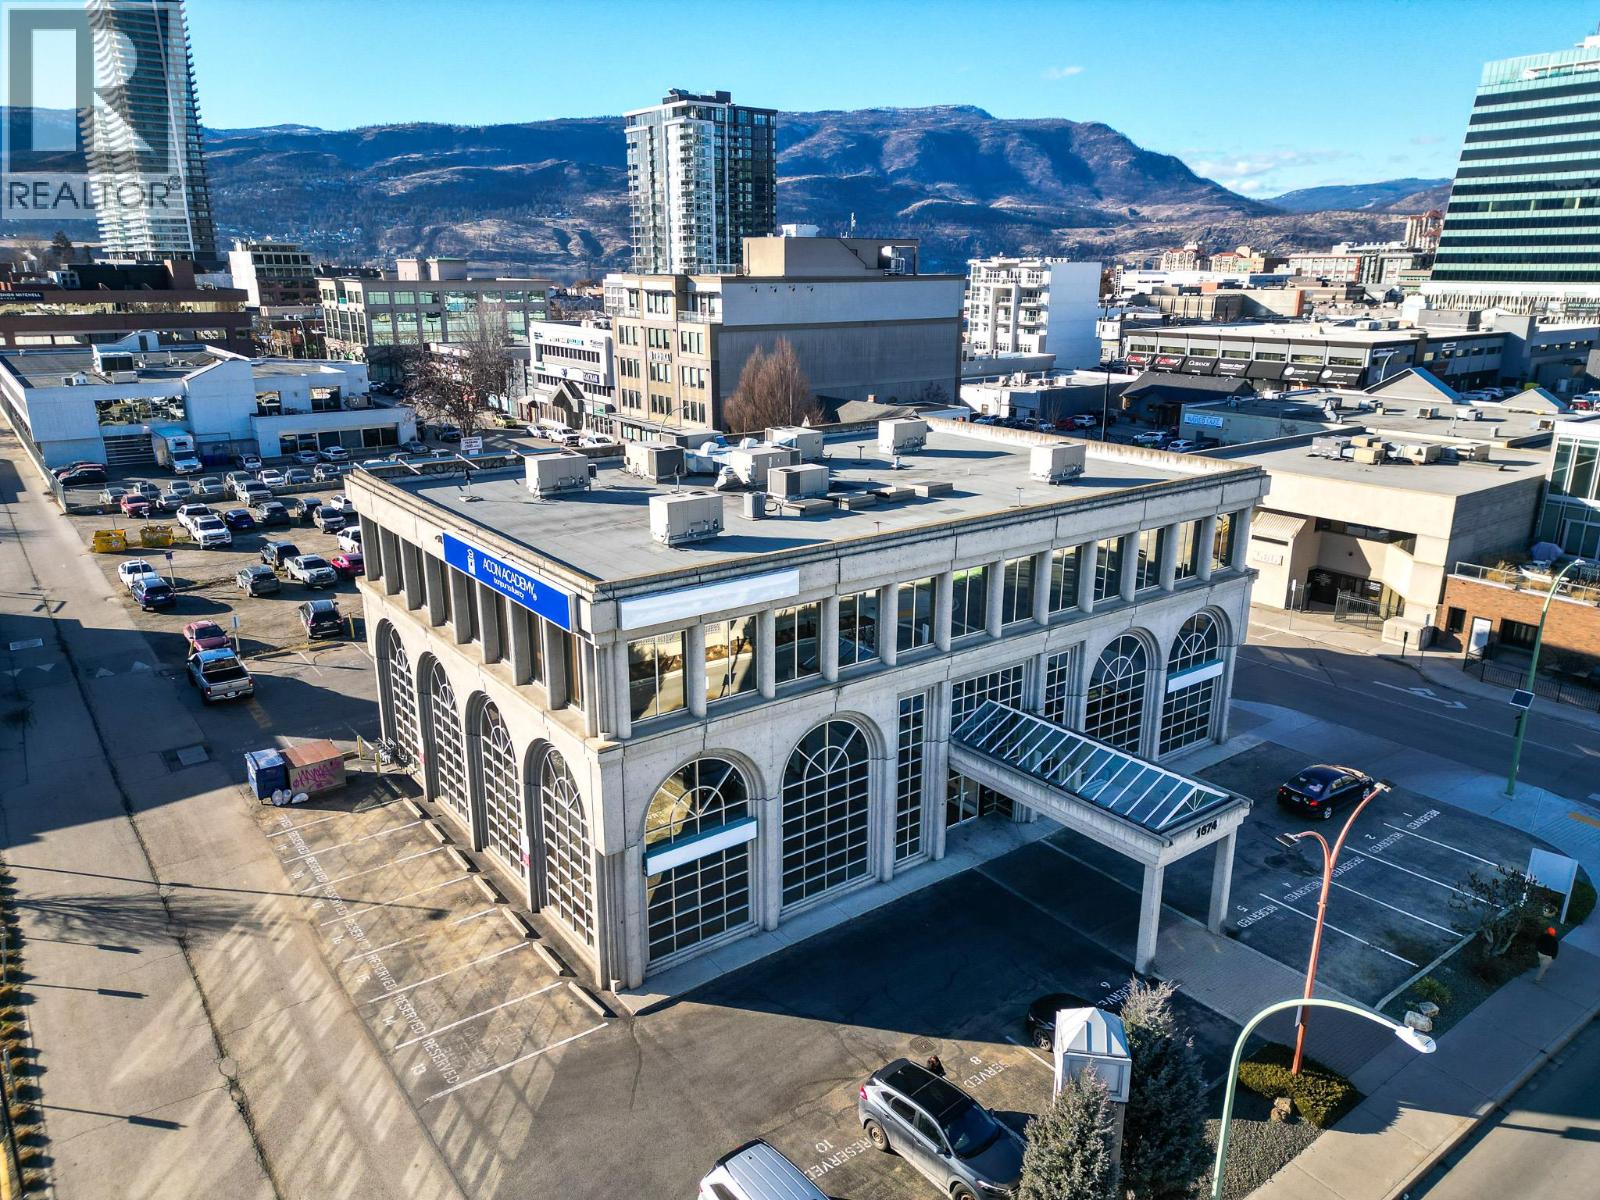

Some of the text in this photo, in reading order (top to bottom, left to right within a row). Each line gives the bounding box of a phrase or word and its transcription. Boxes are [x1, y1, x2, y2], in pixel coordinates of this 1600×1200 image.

[502, 568, 535, 596] ACADEMY
[1196, 819, 1218, 838] 1674
[1406, 809, 1440, 830] RESERVED
[1368, 832, 1404, 854] RESERVED
[1236, 905, 1249, 913] 5
[1236, 905, 1278, 928] RESERVED
[366, 953, 398, 991] RESERVED
[393, 993, 426, 1035] RESERVED
[420, 1037, 460, 1084] RESERVED
[969, 1055, 982, 1065] 8
[815, 1138, 835, 1153] 10
